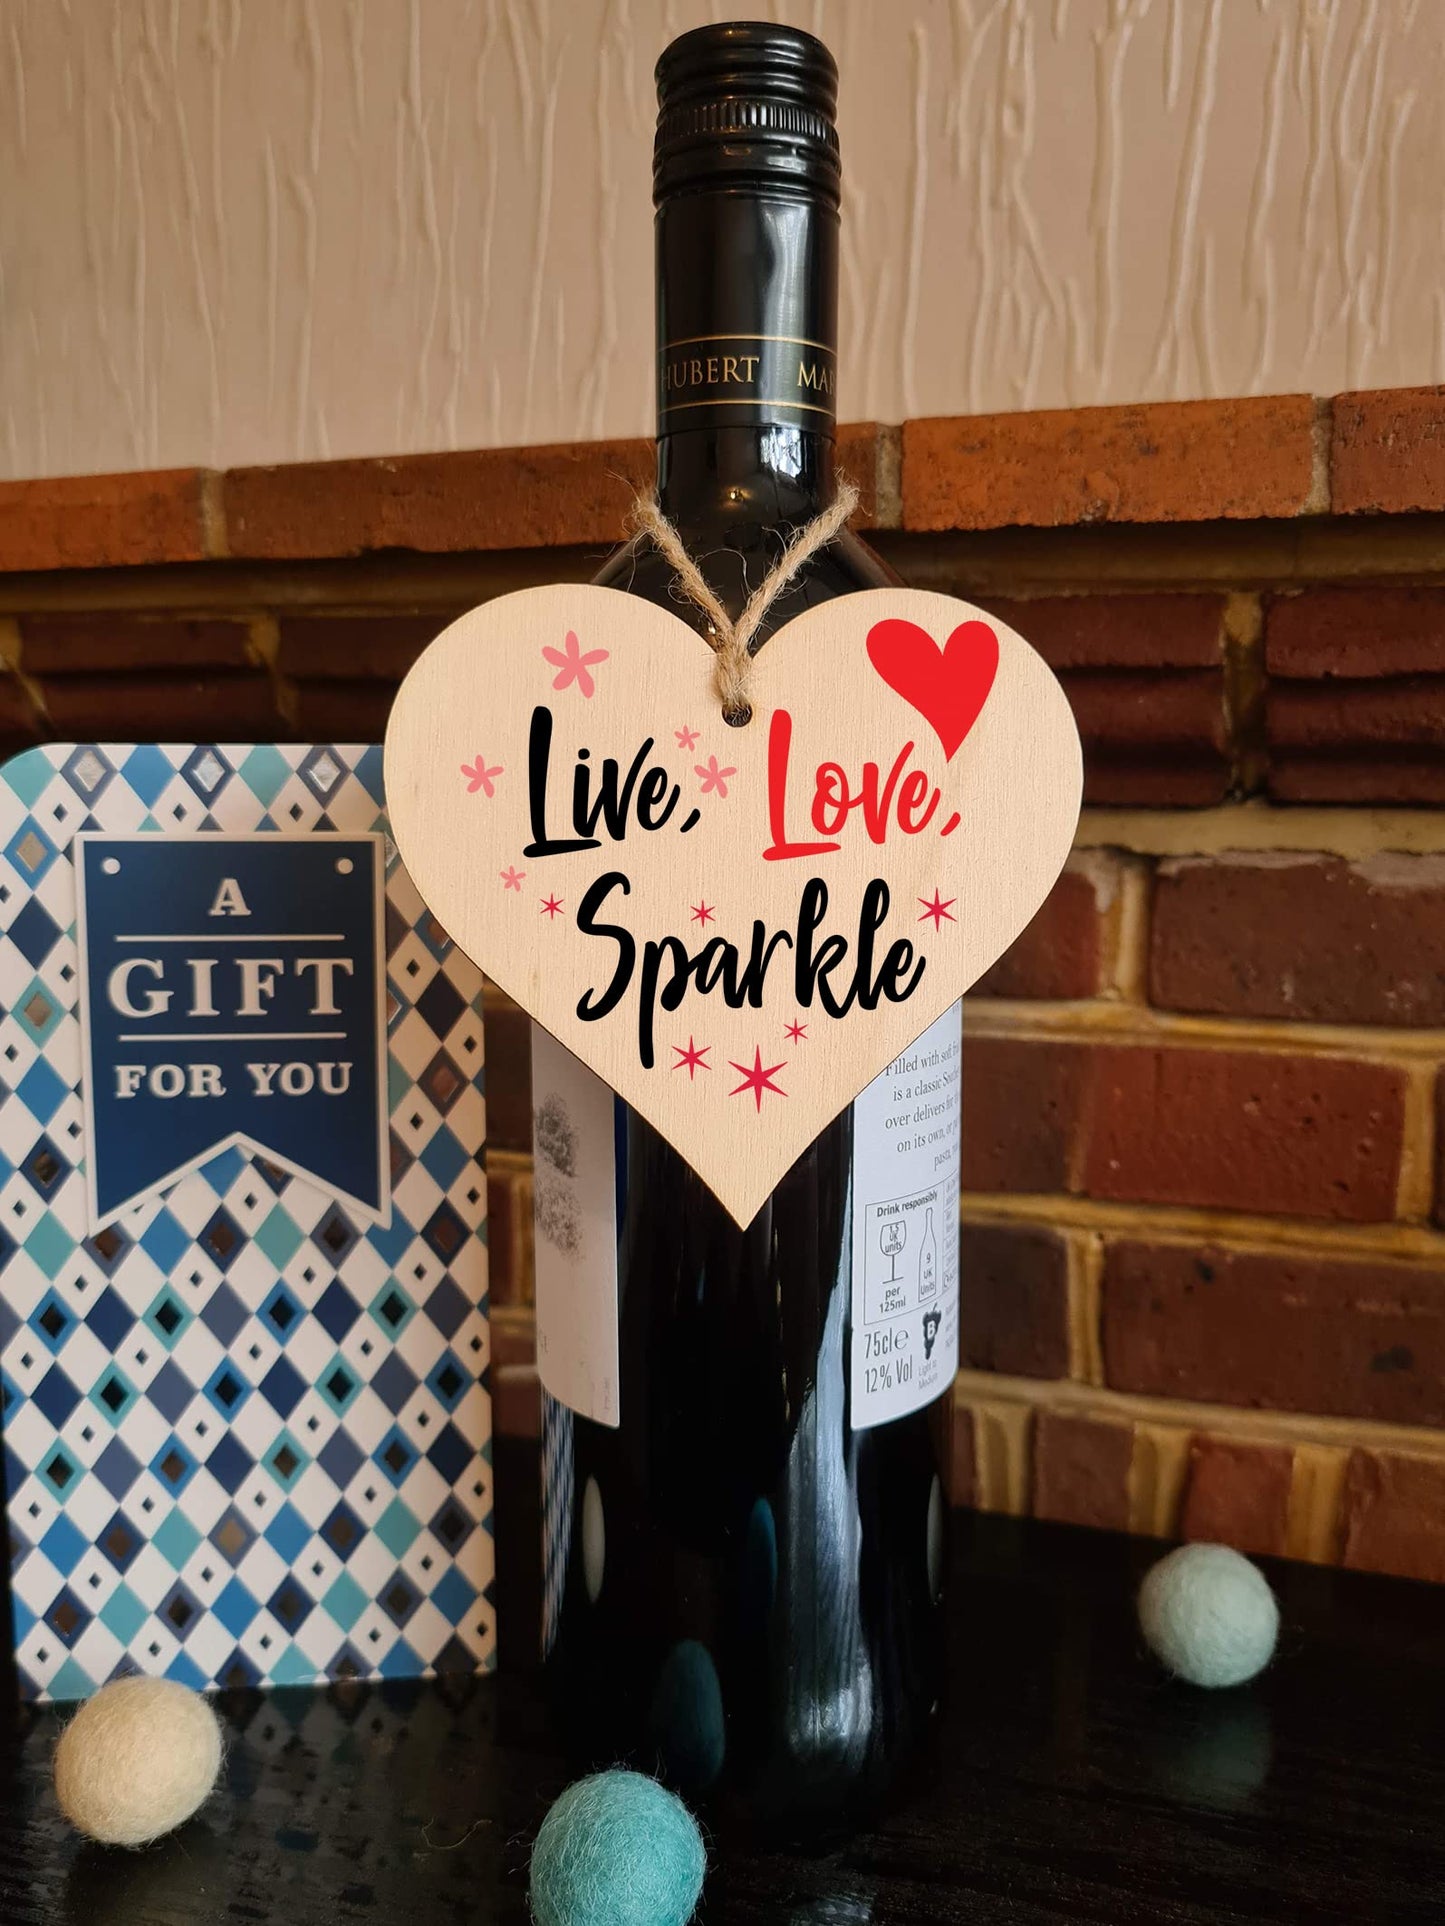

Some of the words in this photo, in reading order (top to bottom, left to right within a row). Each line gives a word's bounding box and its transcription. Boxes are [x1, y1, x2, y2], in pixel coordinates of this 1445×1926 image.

[523, 706, 701, 858] Live,
[762, 708, 961, 861] Love,
[208, 878, 252, 916] A
[576, 871, 927, 1069] Sparkle
[107, 957, 355, 1019] GIFT
[921, 1049, 940, 1068] with
[114, 1063, 228, 1099] FOR
[246, 1061, 353, 1096] YOU
[893, 1085, 903, 1102] is
[905, 1087, 912, 1099] a
[914, 1075, 942, 1097] classic
[885, 1113, 911, 1129] over
[912, 1102, 946, 1124] delivers
[897, 1140, 911, 1153] on
[914, 1133, 926, 1149] its
[877, 1202, 901, 1217] Drink
[889, 1231, 899, 1242] UK
[884, 1241, 903, 1254] units
[926, 1252, 932, 1264] 9
[885, 1286, 901, 1301] per
[879, 1296, 906, 1314] 125ml
[927, 1320, 936, 1340] B
[864, 1362, 892, 1394] 12%
[896, 1354, 913, 1384] Vol
